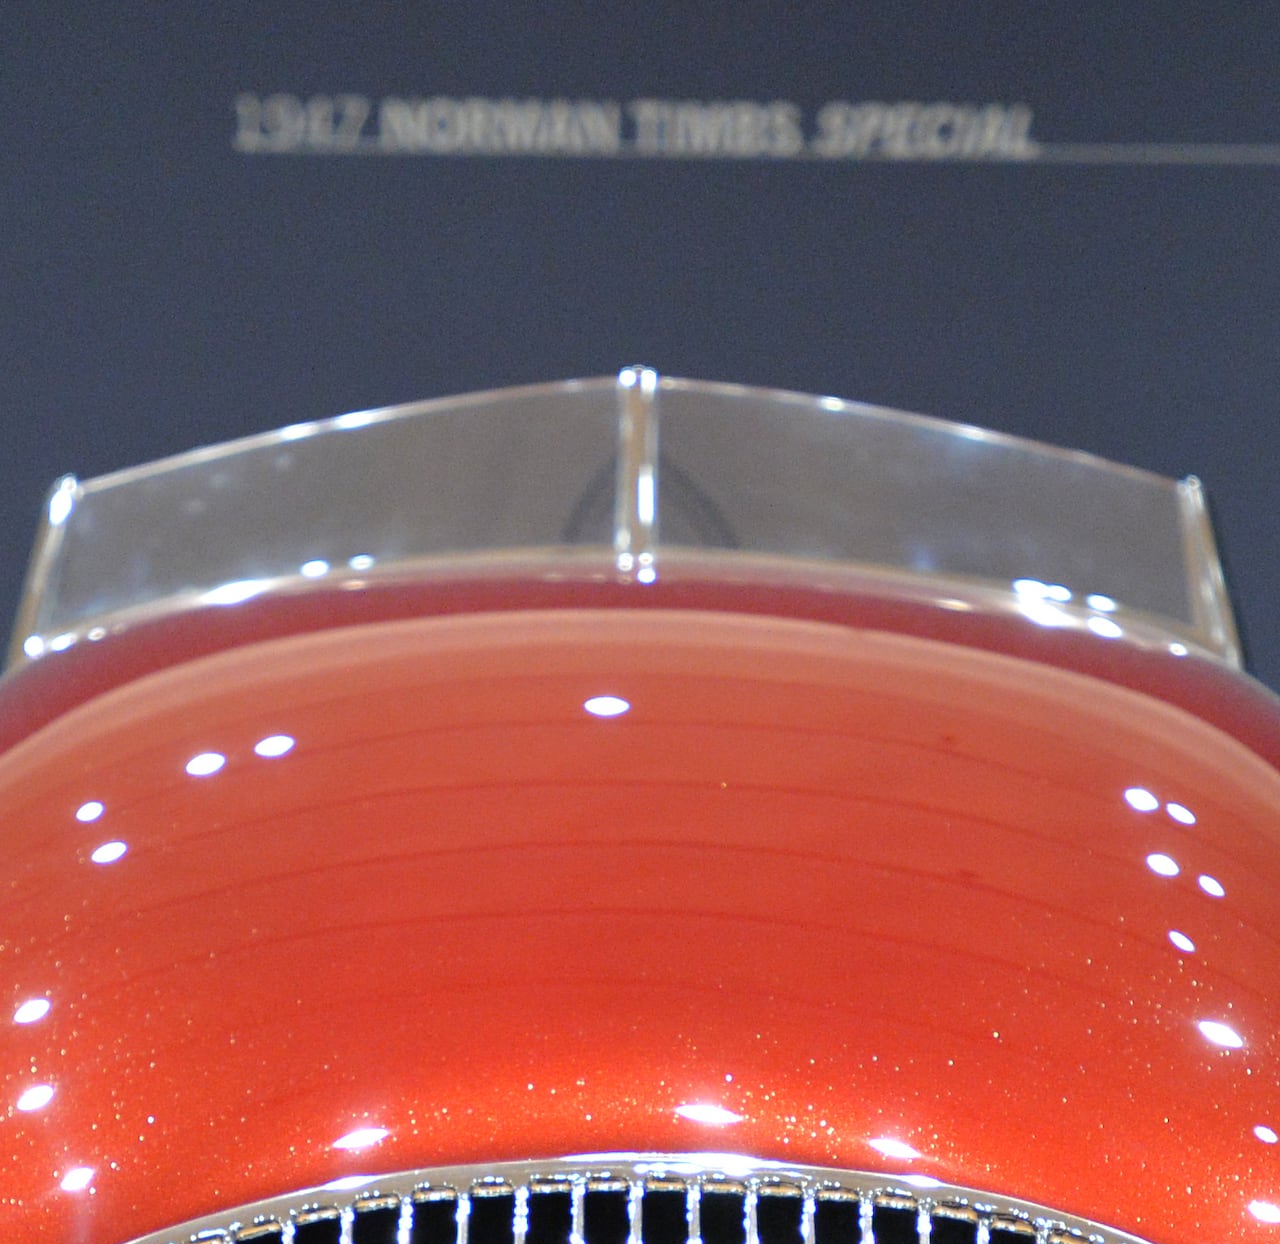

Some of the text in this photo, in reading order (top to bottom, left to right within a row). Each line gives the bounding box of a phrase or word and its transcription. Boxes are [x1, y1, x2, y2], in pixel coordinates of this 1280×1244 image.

[235, 94, 1039, 160] 1947 NORMAN TIMBS SPECIAL
